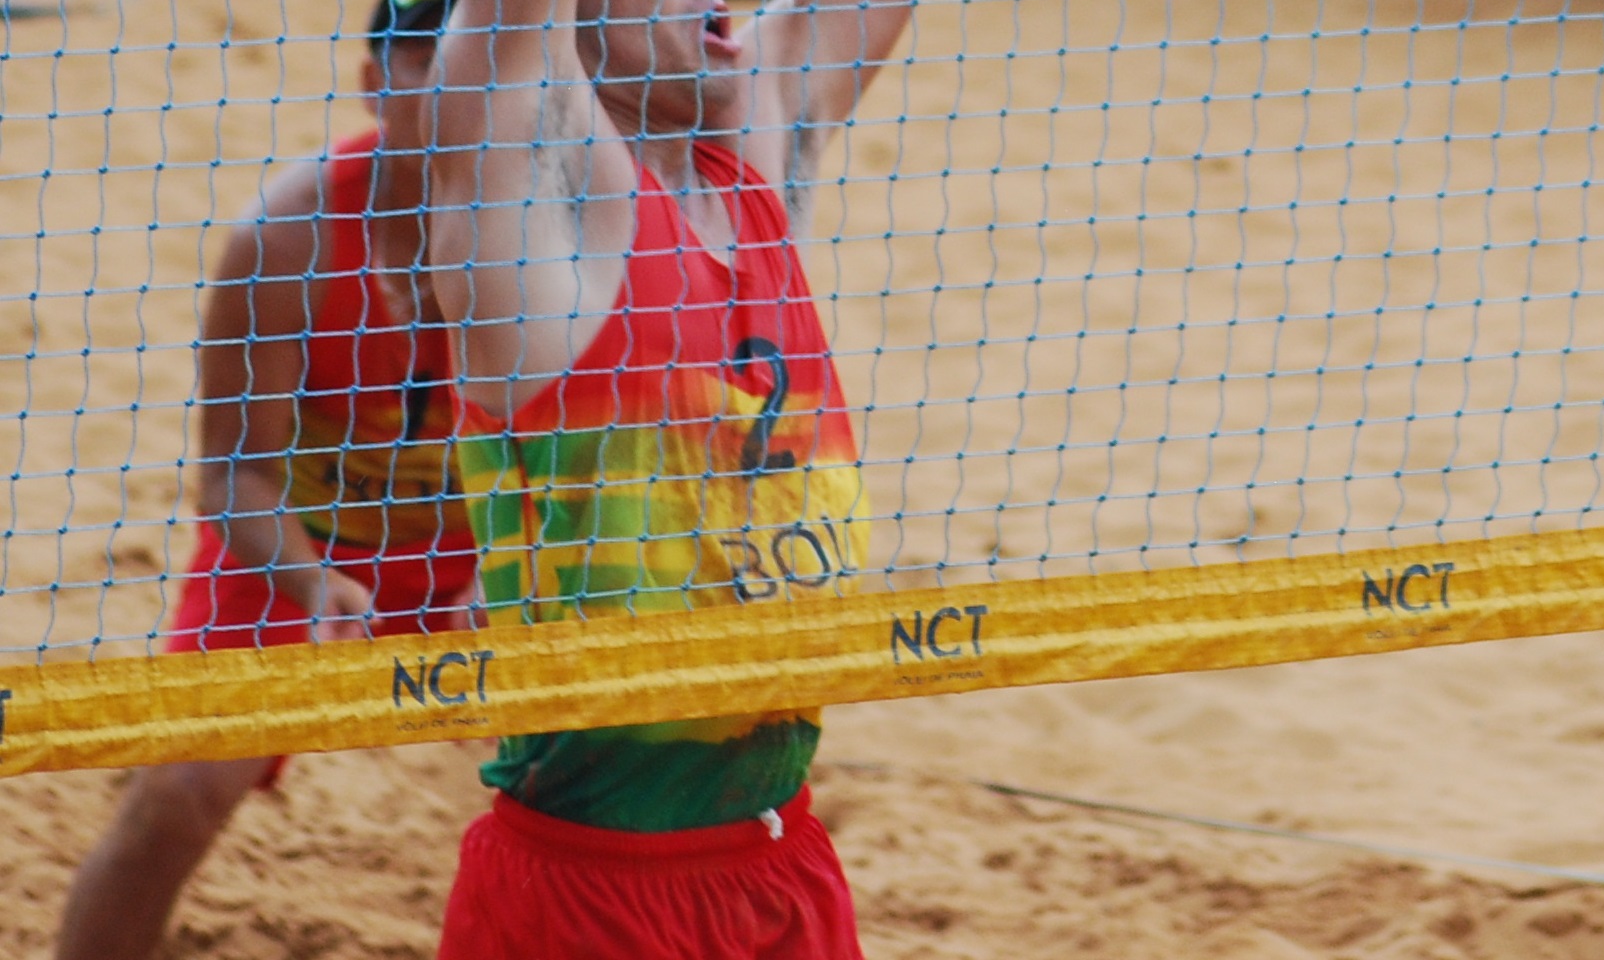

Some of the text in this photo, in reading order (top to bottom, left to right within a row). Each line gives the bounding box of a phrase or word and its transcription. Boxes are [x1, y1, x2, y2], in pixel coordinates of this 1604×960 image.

[733, 336, 795, 477] 2
[1361, 562, 1454, 616] NCT
[890, 604, 988, 665] NCT
[392, 649, 494, 709] NCT
